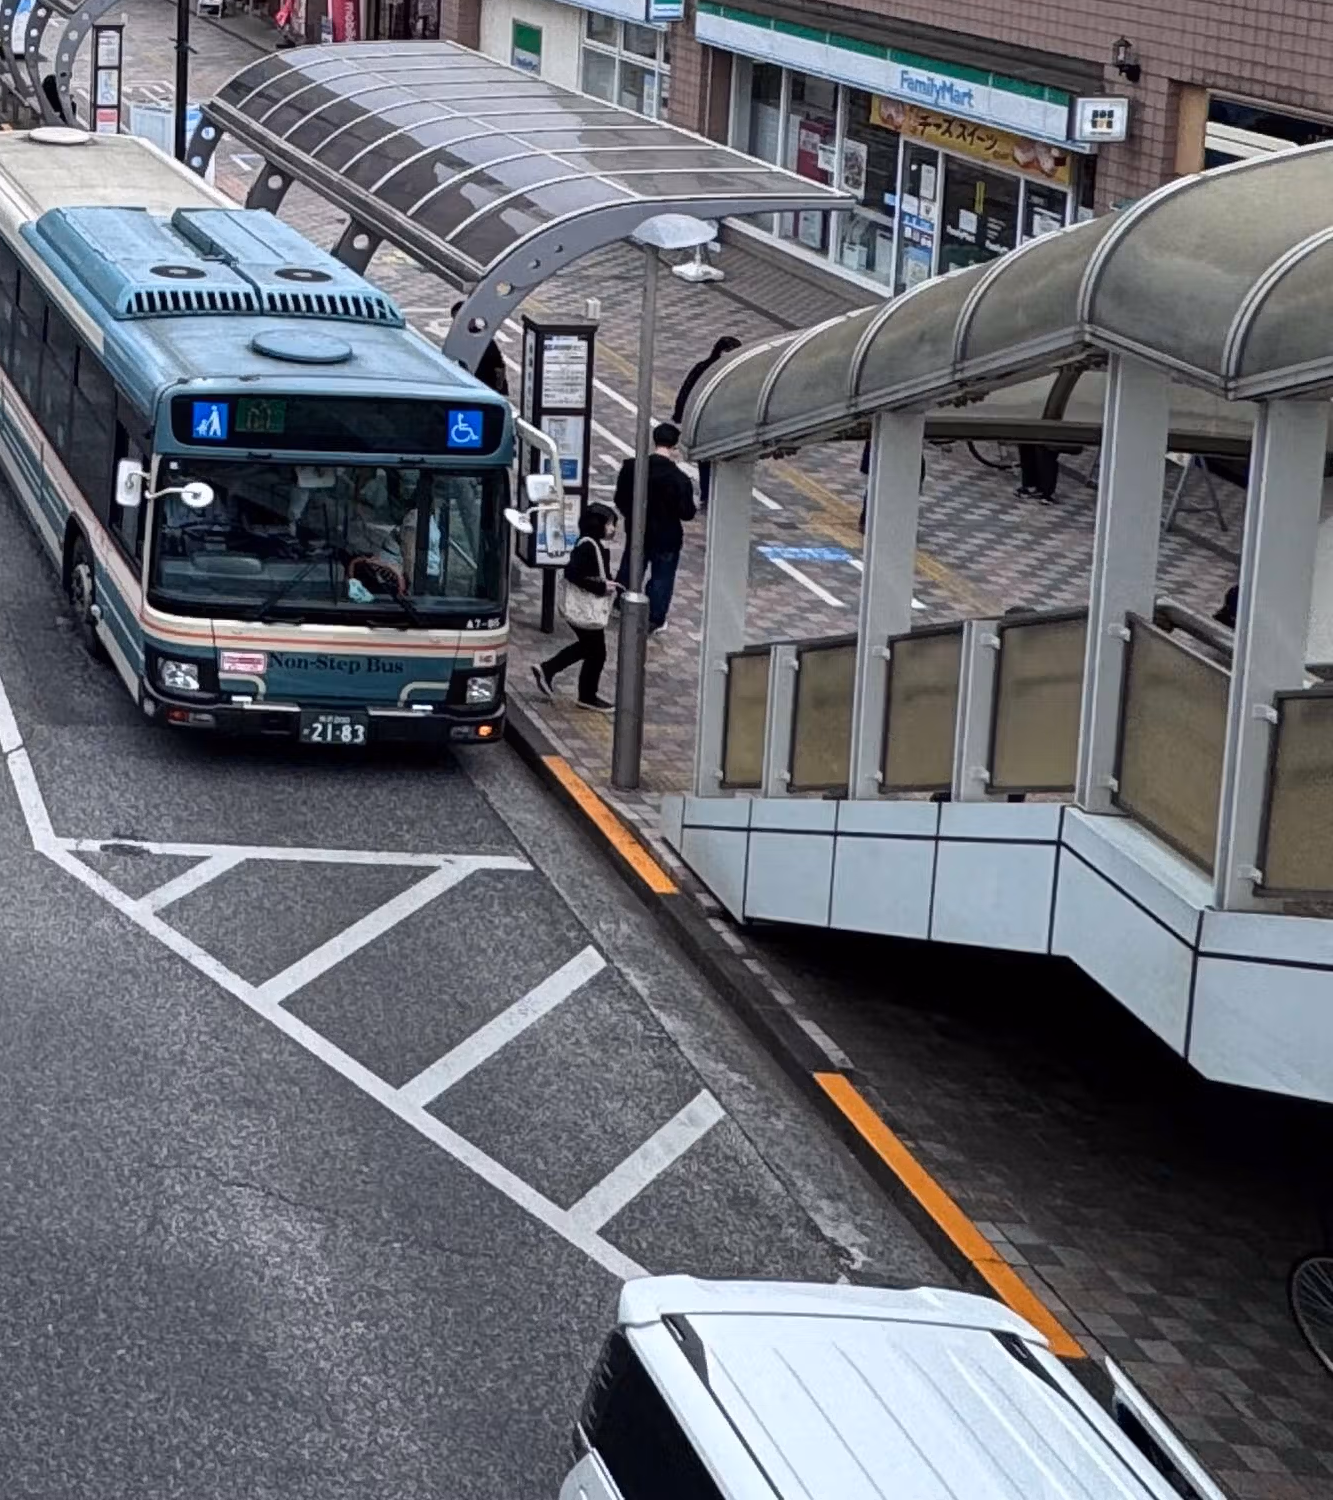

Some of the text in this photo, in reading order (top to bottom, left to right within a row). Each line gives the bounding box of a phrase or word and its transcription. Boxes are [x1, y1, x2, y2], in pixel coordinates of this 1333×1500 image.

[900, 69, 975, 109] FamilyMart
[270, 653, 361, 675] Non-Step
[367, 658, 404, 673] Bus
